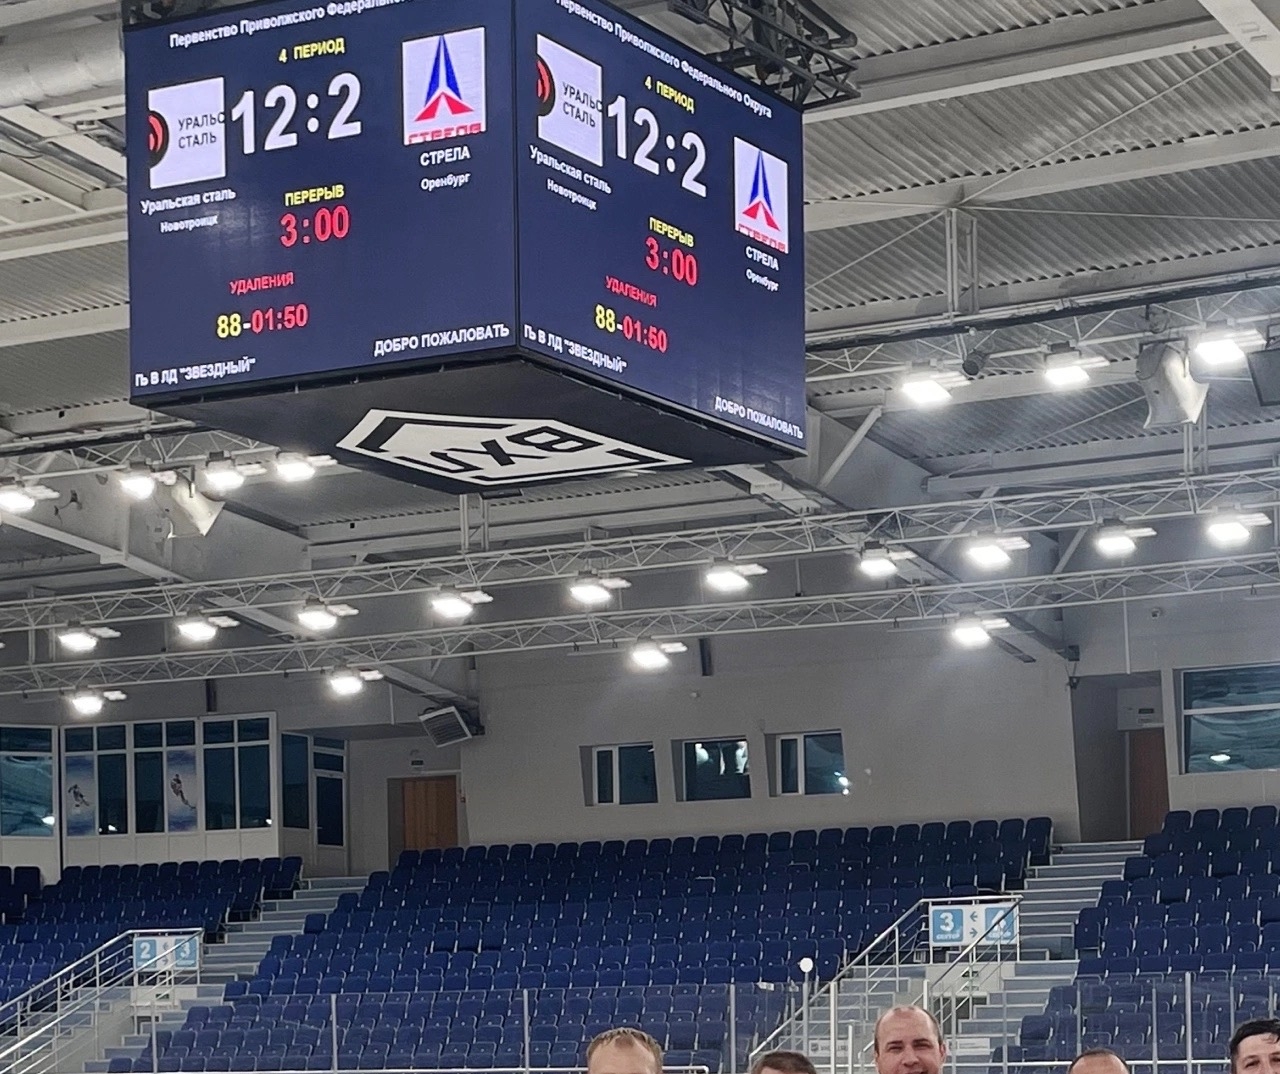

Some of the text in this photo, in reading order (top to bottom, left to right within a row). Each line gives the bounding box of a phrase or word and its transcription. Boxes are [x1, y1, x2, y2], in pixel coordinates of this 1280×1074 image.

[170, 0, 408, 47] Первенство Приволжского Федерально
[278, 38, 345, 63] 4 ПЕРИОД
[615, 22, 680, 69] Приволжского
[681, 58, 742, 103] Федерального
[744, 95, 772, 119] Округа
[644, 76, 695, 114] 4 ПЕРИОД
[231, 72, 362, 154] 12:2
[563, 103, 596, 128] СТАЛЬ
[178, 131, 218, 149] СТАЛЬ
[420, 145, 471, 166] СТРЕЛА
[607, 95, 707, 198] 12:2
[420, 173, 471, 192] Оренбург
[529, 145, 612, 195] Уральская сталь
[140, 188, 236, 215] Уральская сталь
[285, 184, 345, 207] ПЕРЕРЫВ
[547, 178, 597, 211] Новотроицк
[160, 214, 218, 233] Новотроицк
[280, 206, 350, 248] 3:00
[649, 216, 694, 248] ПЕРЕРЫВ
[645, 236, 698, 286] 3:00
[745, 246, 779, 271] СТРЕЛА
[229, 272, 294, 295] УДАЛЕНИЯ
[605, 275, 657, 308] УДАЛЕНИЯ
[745, 268, 779, 292] Оренбург
[217, 303, 309, 338] 88-01:50
[595, 304, 668, 354] 88-01:50
[374, 323, 510, 357] ДОБРО ПОЖАЛОВАТЬ
[537, 329, 546, 344] В
[547, 333, 563, 354] ЛД
[564, 339, 627, 373] "ЗВЕЗДНЫЙ"
[150, 371, 160, 385] В
[161, 369, 179, 385] ЛД
[180, 356, 256, 380] "ЗВЕЗДНЫЙ"
[714, 396, 804, 440] ДОБРО ПОЖАЛОВАТЬ
[939, 912, 955, 932] 3
[140, 941, 152, 959] 2
[180, 941, 191, 958] 3
